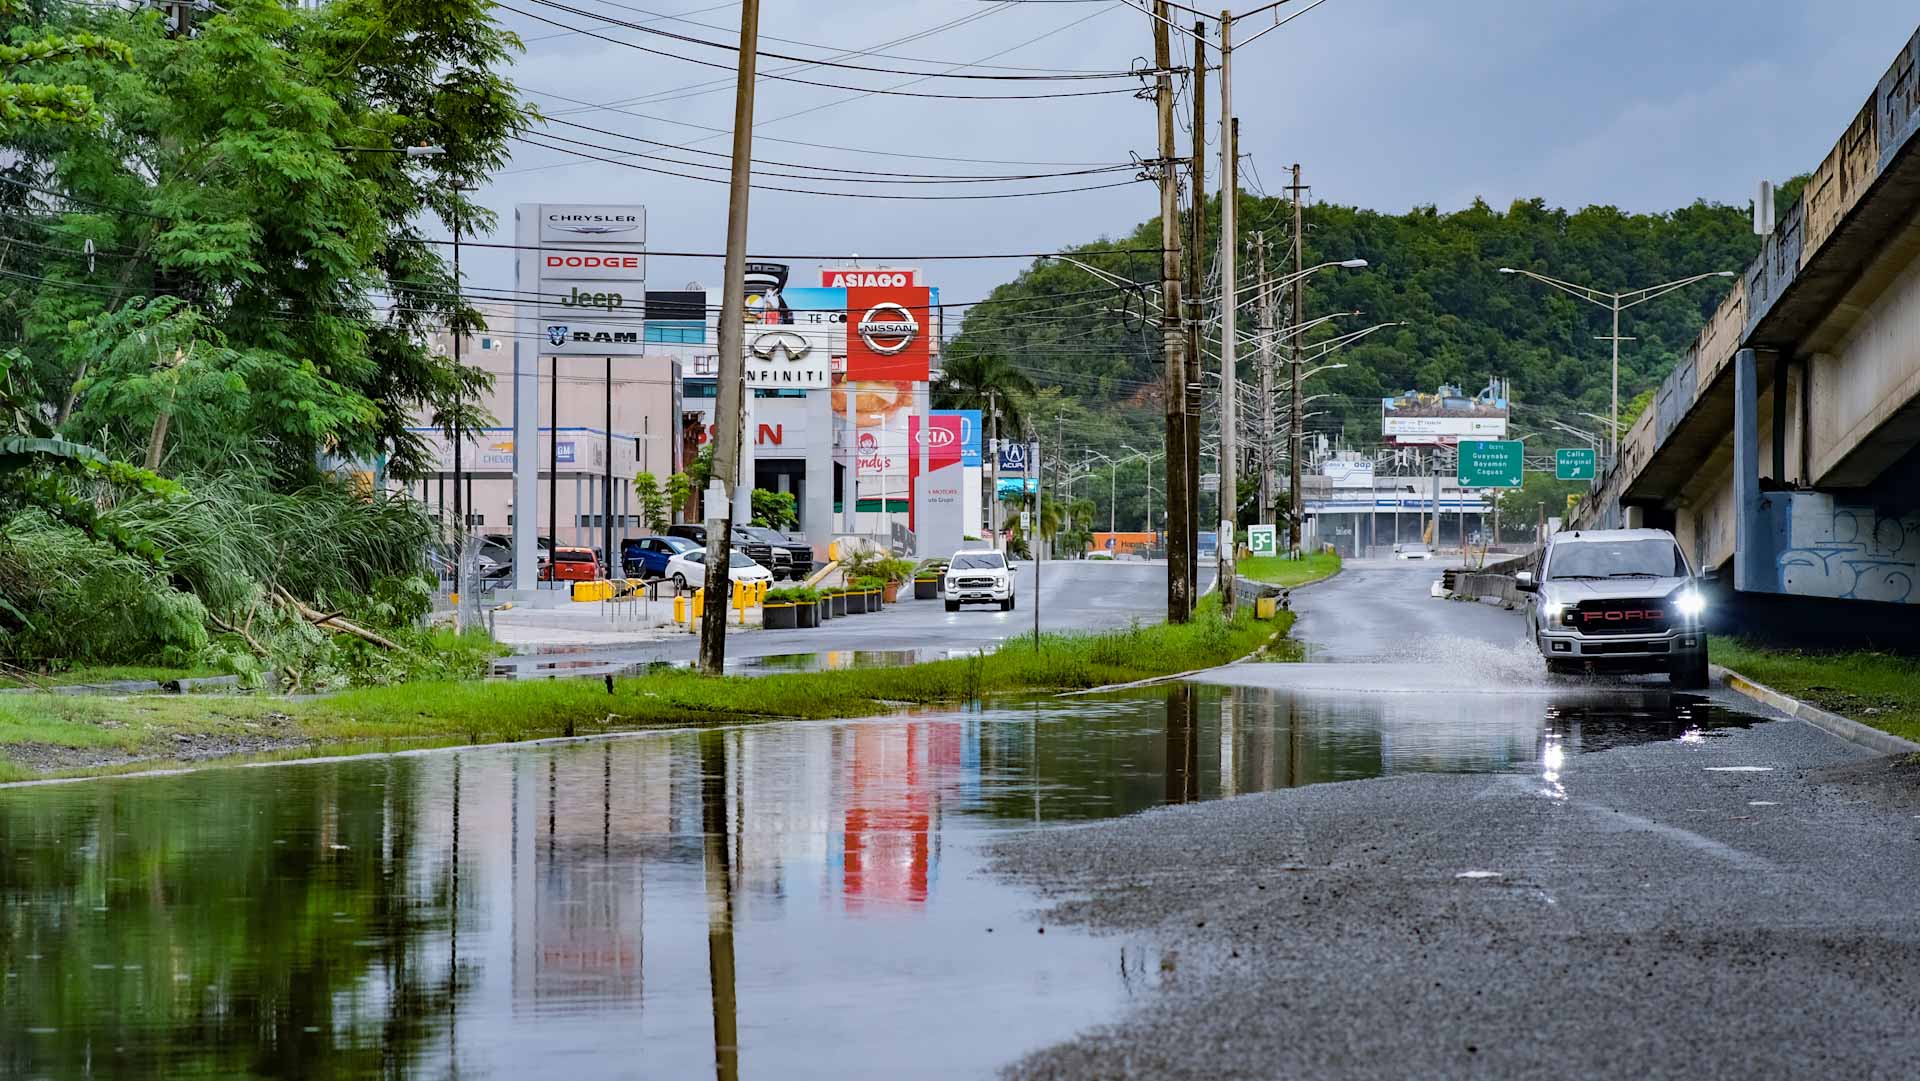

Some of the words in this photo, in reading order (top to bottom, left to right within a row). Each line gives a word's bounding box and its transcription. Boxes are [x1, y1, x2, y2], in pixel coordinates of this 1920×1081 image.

[549, 214, 636, 222] CHRYSLER
[547, 256, 638, 268] DODGE
[831, 273, 907, 288] ASIAGO
[561, 287, 623, 312] Jeep
[808, 313, 822, 324] TE
[864, 324, 912, 332] NISSAN
[573, 331, 637, 343] RAM
[746, 370, 824, 382] NFINITI
[557, 446, 571, 455] GM
[1566, 450, 1585, 458] Calle
[483, 455, 513, 464] CHEVR
[1472, 452, 1509, 461] Guaynabo
[856, 453, 891, 473] endy's
[1559, 458, 1592, 467] Marginal
[1476, 468, 1504, 476] Caguas
[1583, 609, 1664, 622] FORD
